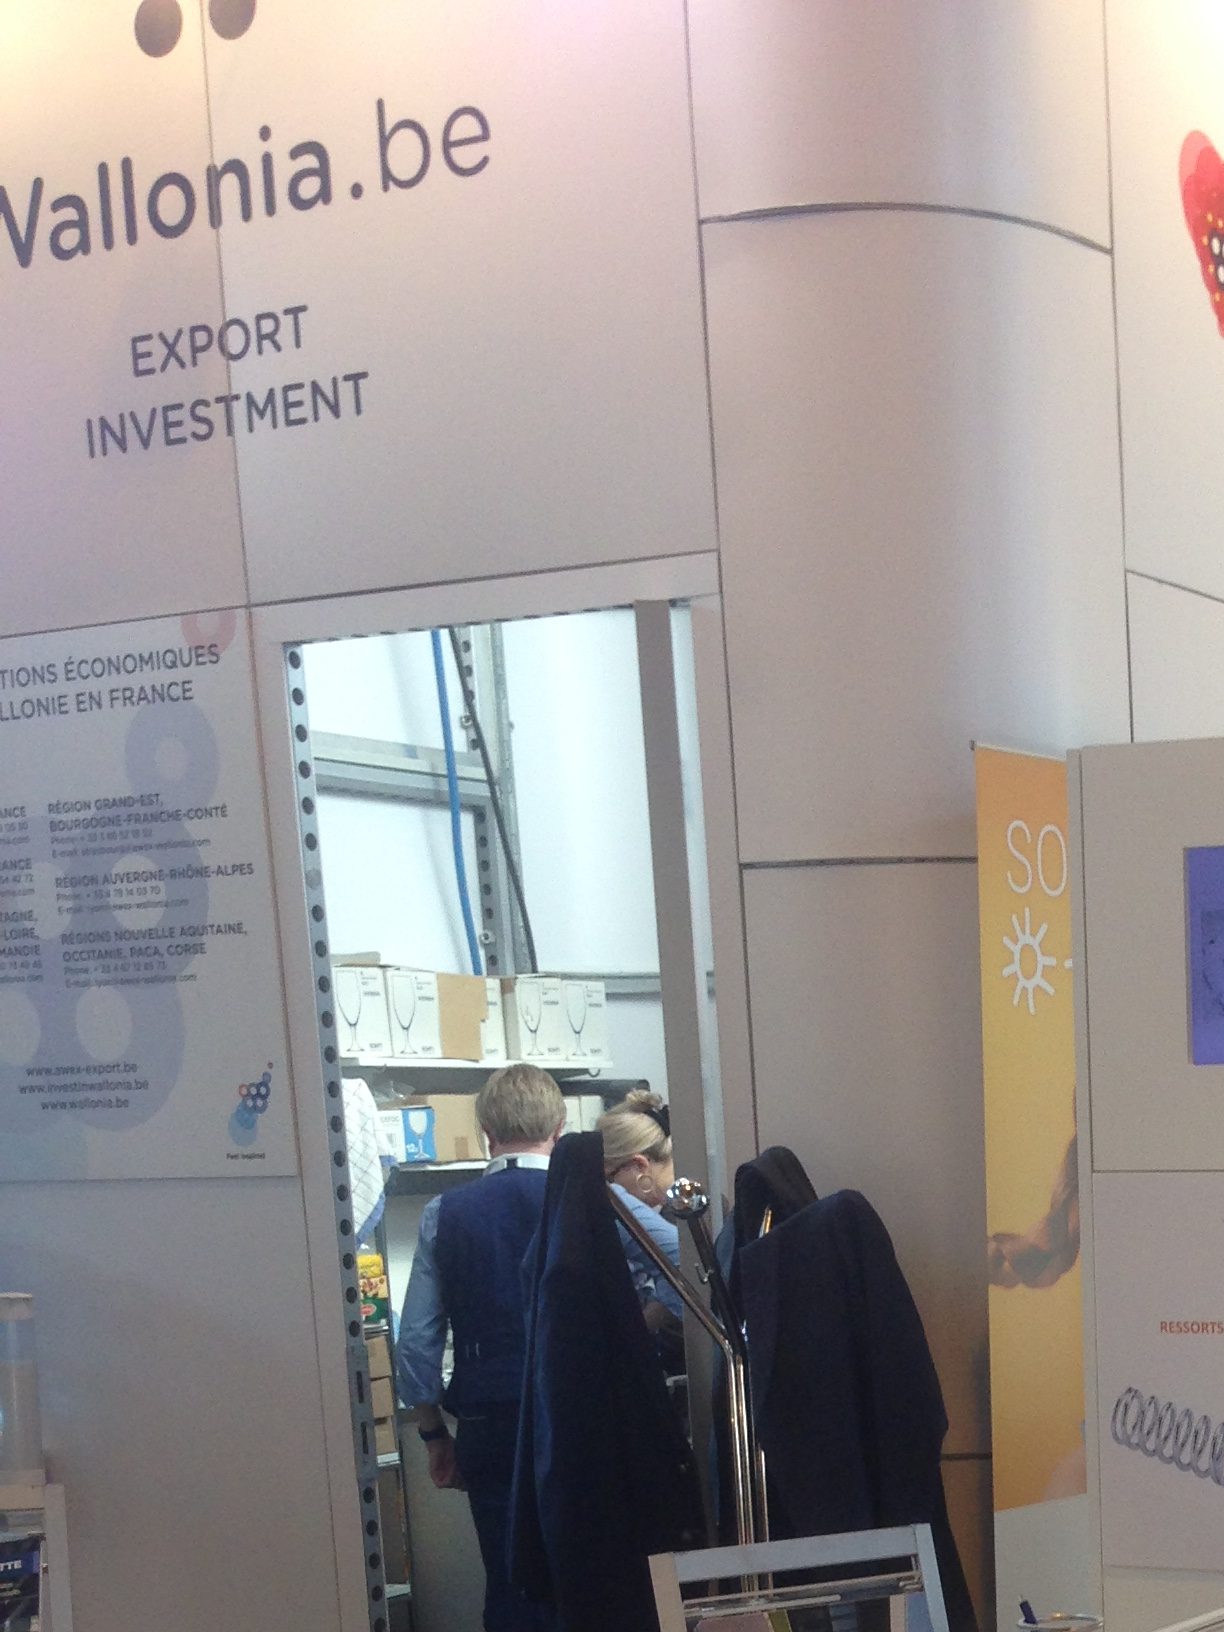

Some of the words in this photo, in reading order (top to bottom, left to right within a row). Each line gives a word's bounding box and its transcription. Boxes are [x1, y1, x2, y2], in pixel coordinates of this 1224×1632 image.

[130, 305, 309, 377] EXPORT
[86, 371, 370, 459] INVESTMENT
[64, 644, 220, 682] ÉCONOMIQUES
[75, 691, 102, 713] EN
[109, 680, 194, 709] FRANCE
[1160, 1321, 1224, 1336] RESSORTS
